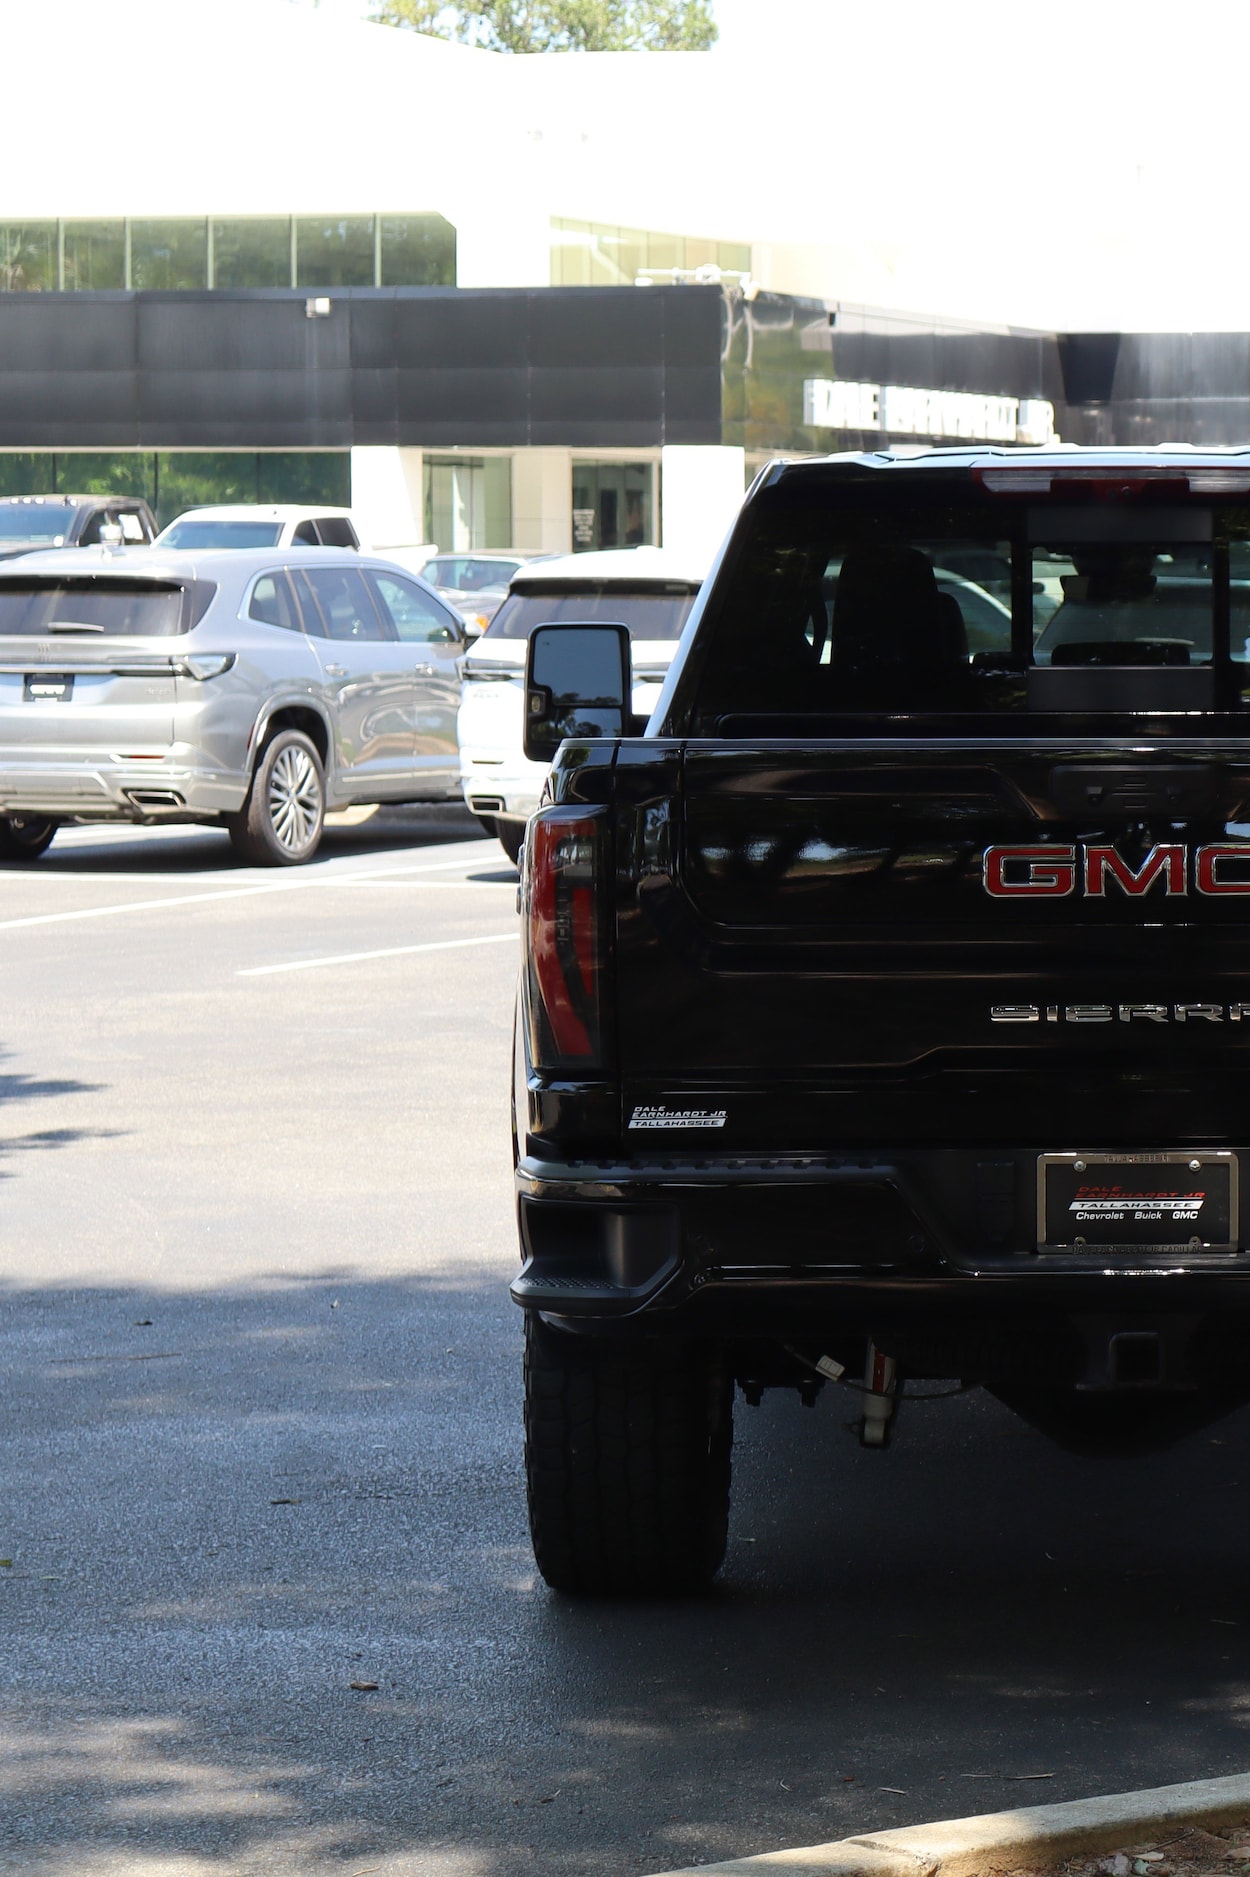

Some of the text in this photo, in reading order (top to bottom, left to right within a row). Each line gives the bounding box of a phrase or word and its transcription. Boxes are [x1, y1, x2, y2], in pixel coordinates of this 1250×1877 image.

[632, 1111, 707, 1119] EARNHARDT
[1076, 1211, 1199, 1220] Chevrolet Buick GMC
